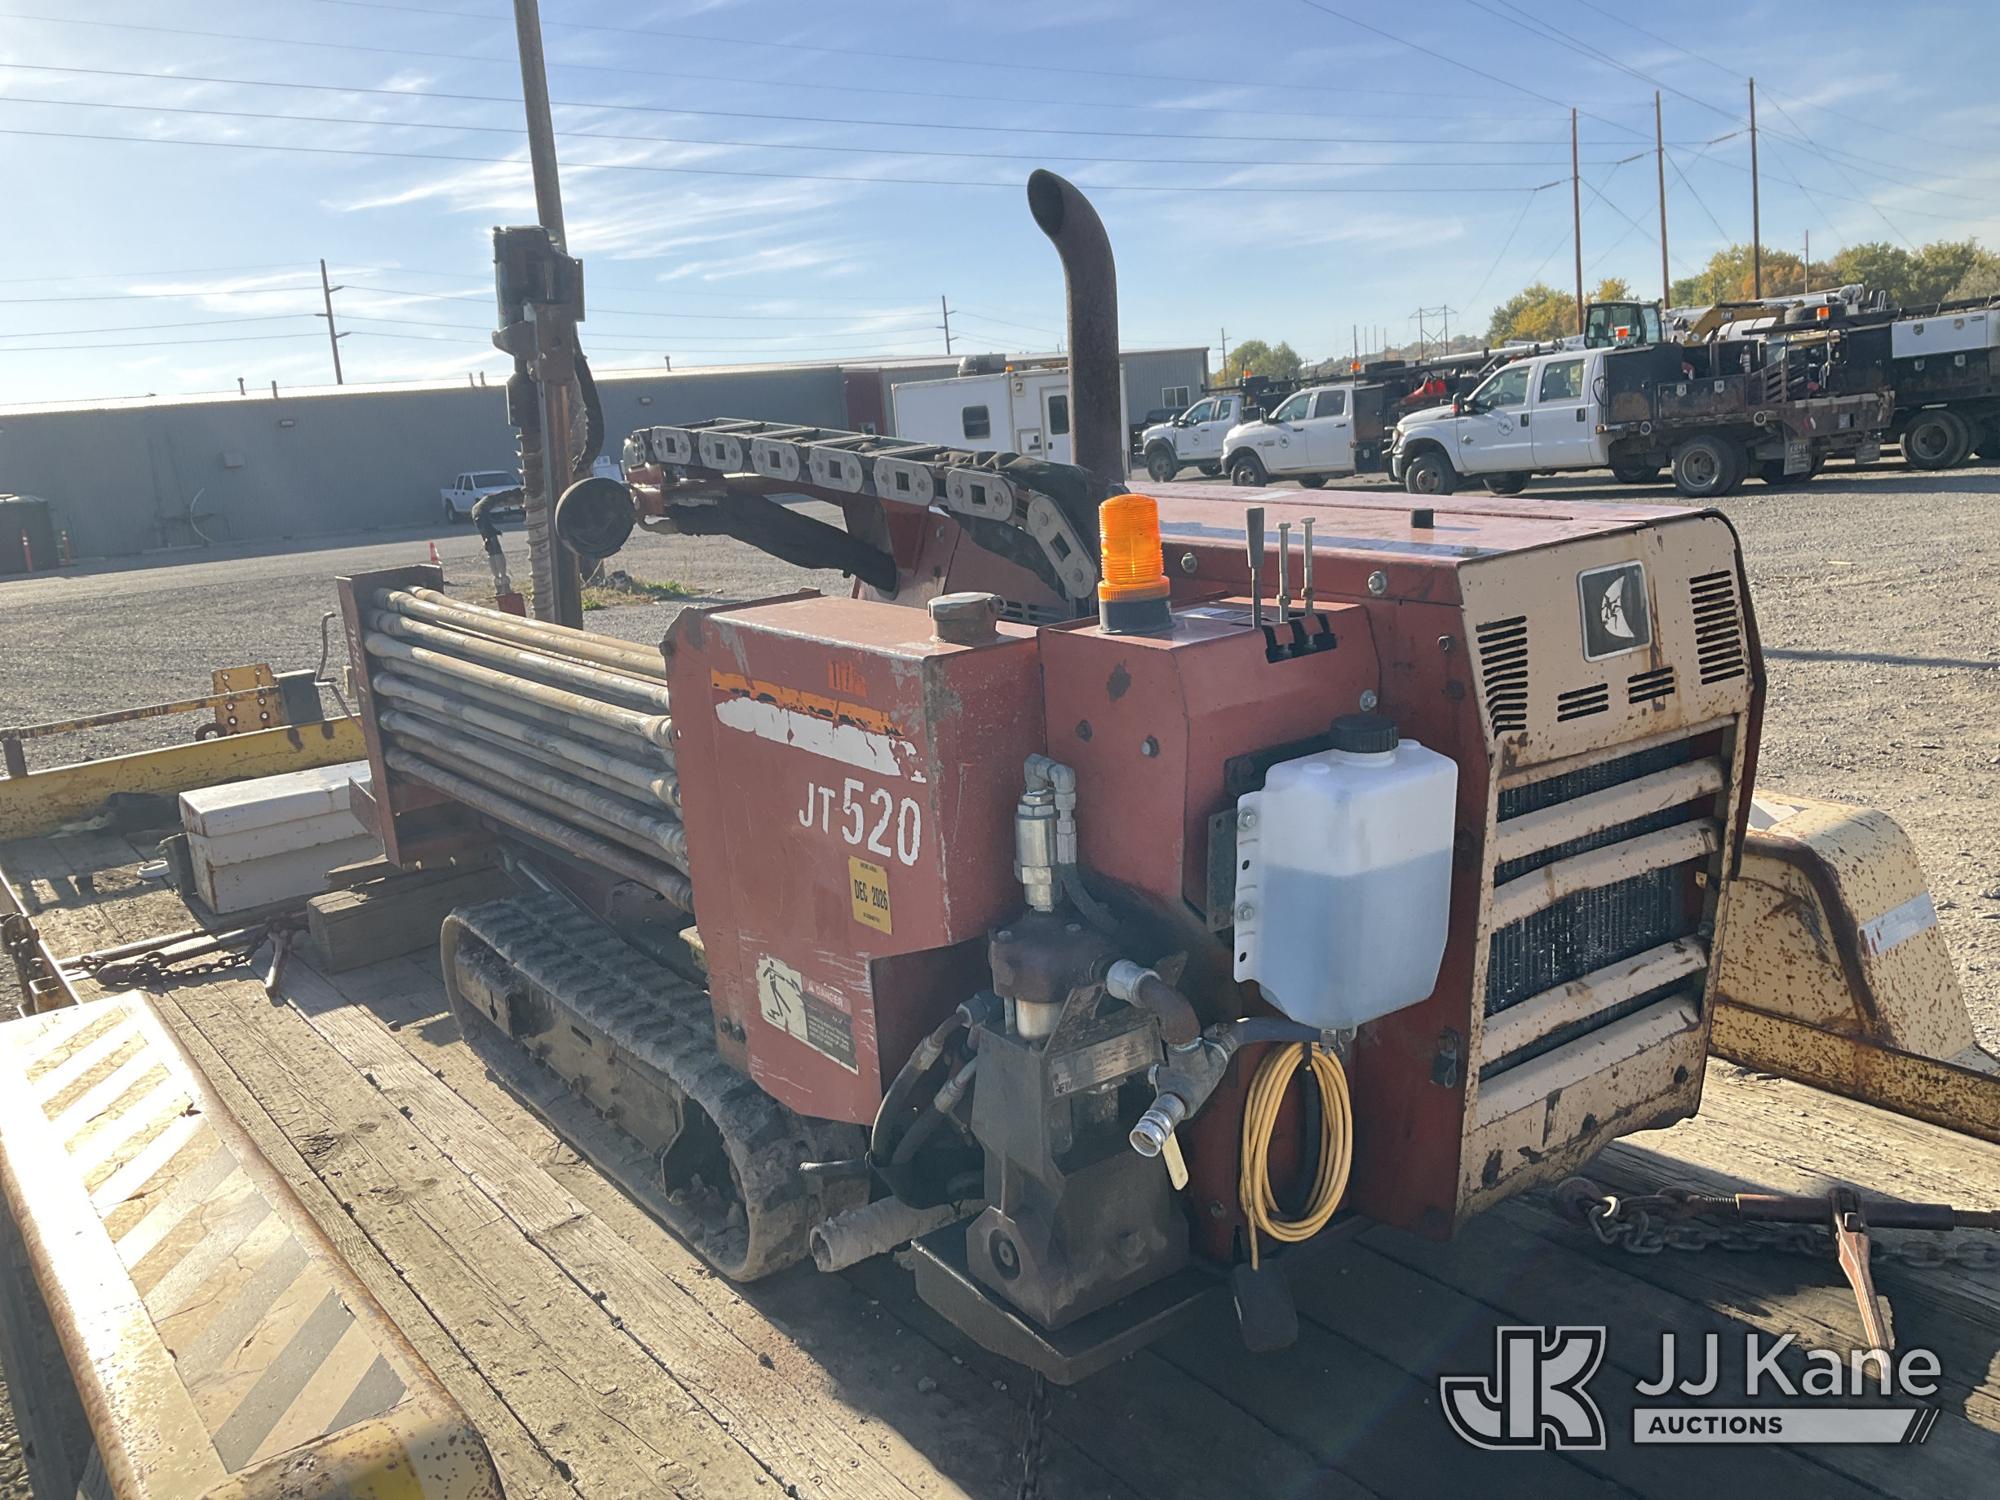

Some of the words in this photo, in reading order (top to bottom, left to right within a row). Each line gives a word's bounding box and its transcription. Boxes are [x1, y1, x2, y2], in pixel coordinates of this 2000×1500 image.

[799, 777, 921, 867] JT520
[854, 879, 868, 903] DEC
[815, 984, 844, 1009] DANGER
